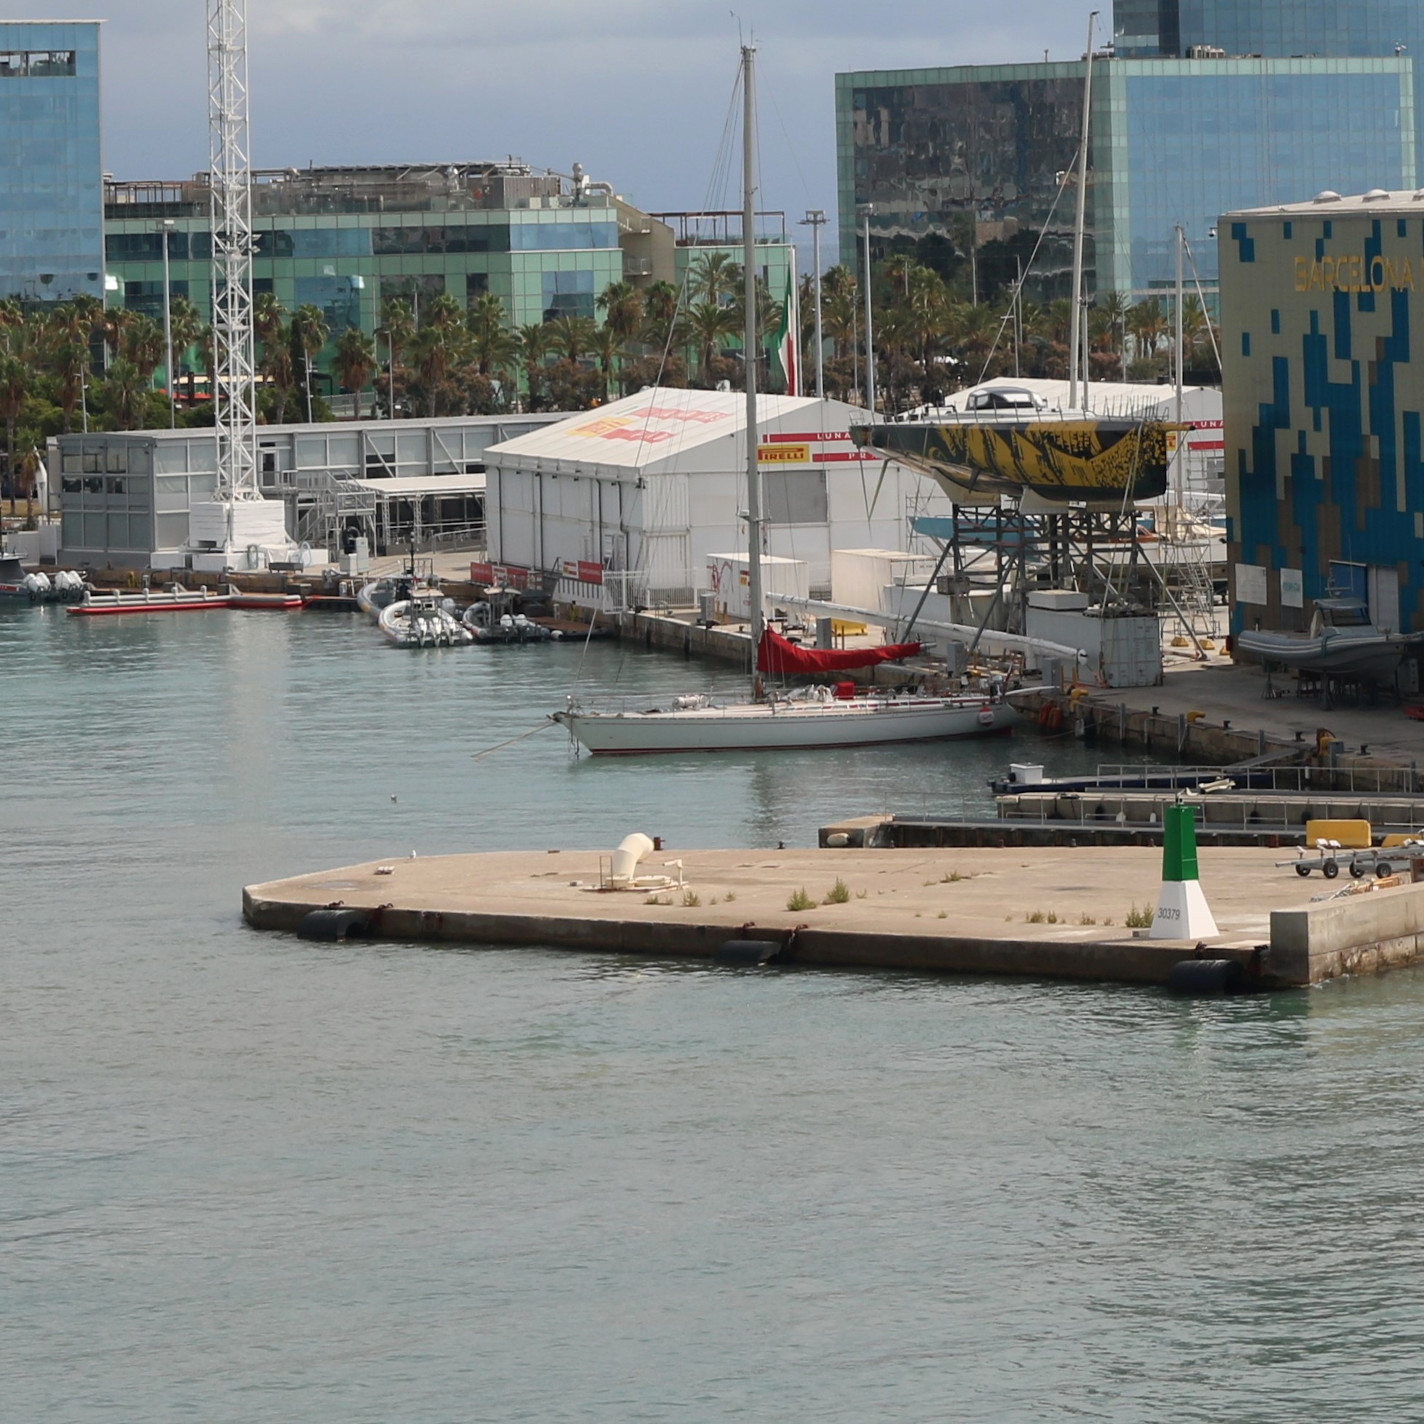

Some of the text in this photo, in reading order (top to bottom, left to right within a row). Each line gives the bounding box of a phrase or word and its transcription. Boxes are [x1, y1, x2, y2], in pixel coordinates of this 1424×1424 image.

[1294, 254, 1416, 293] BARCELONA
[817, 432, 851, 440] LUNA
[1158, 907, 1181, 920] 30379
